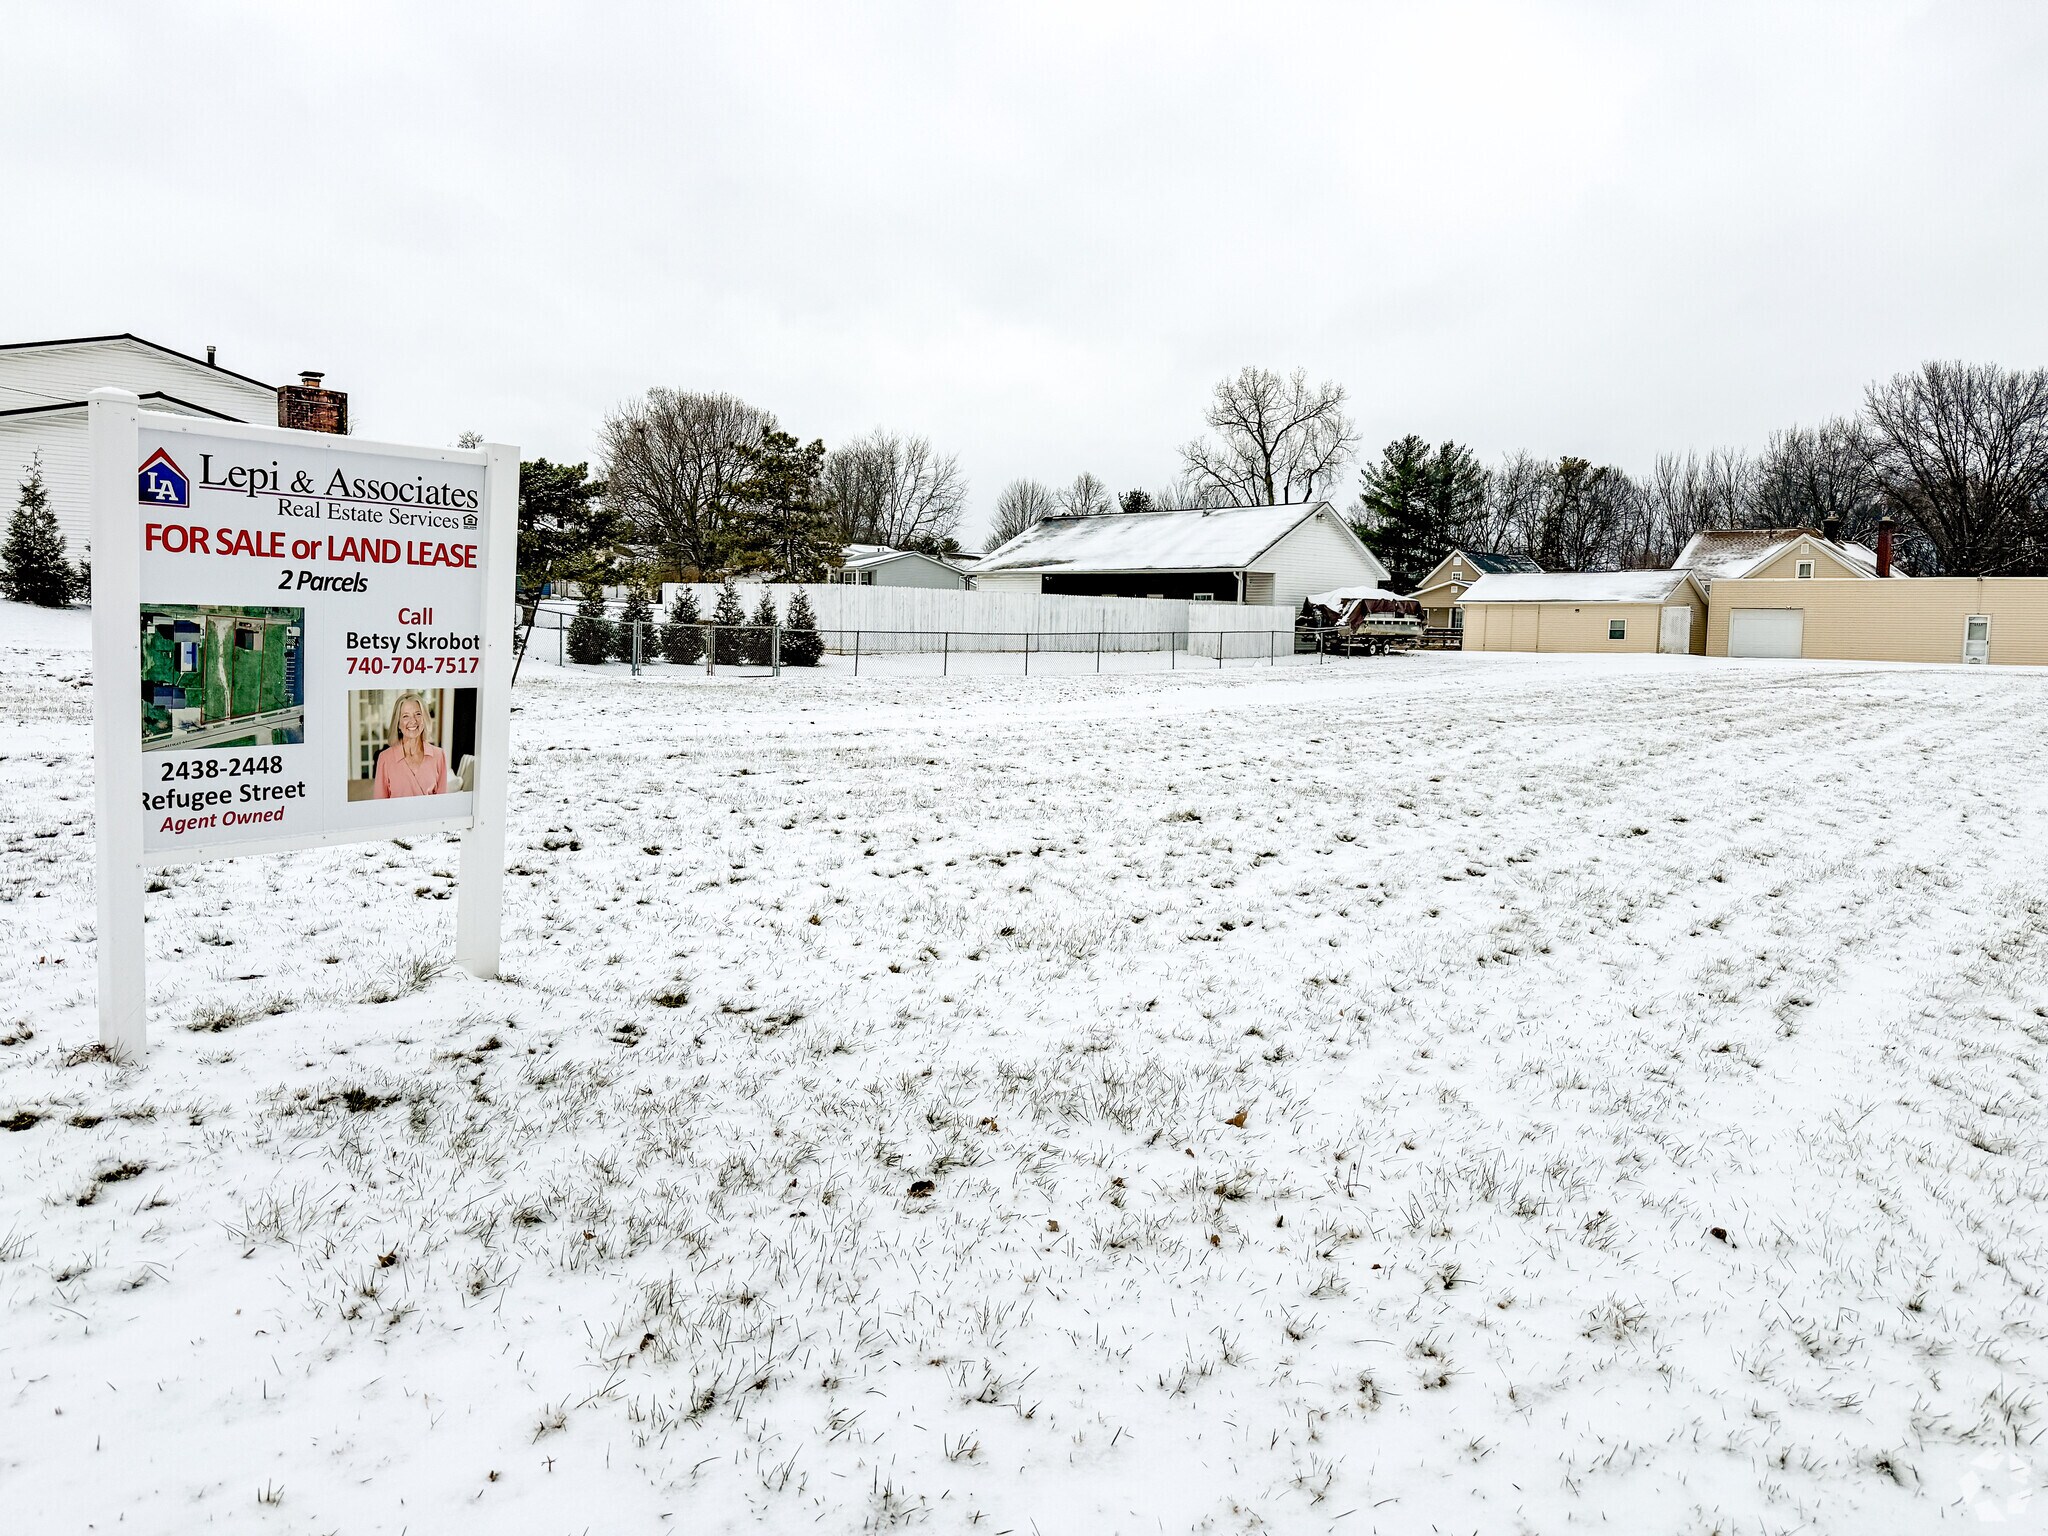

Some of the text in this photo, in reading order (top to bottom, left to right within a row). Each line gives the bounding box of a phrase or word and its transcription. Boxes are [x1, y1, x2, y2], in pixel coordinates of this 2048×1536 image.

[147, 472, 178, 501] LA
[199, 453, 479, 509] Lepi & Associates
[278, 498, 459, 529] Real Estate Services
[145, 523, 477, 568] FOR SALE or LAND LEASE
[278, 569, 368, 593] 2 Parcels
[398, 607, 433, 625] Call
[346, 632, 480, 654] Betsy Skrobot
[346, 656, 479, 674] 740-704-7517
[161, 755, 283, 781] 2438-2448
[240, 780, 306, 803] Street
[160, 806, 284, 834] Agent Owned
